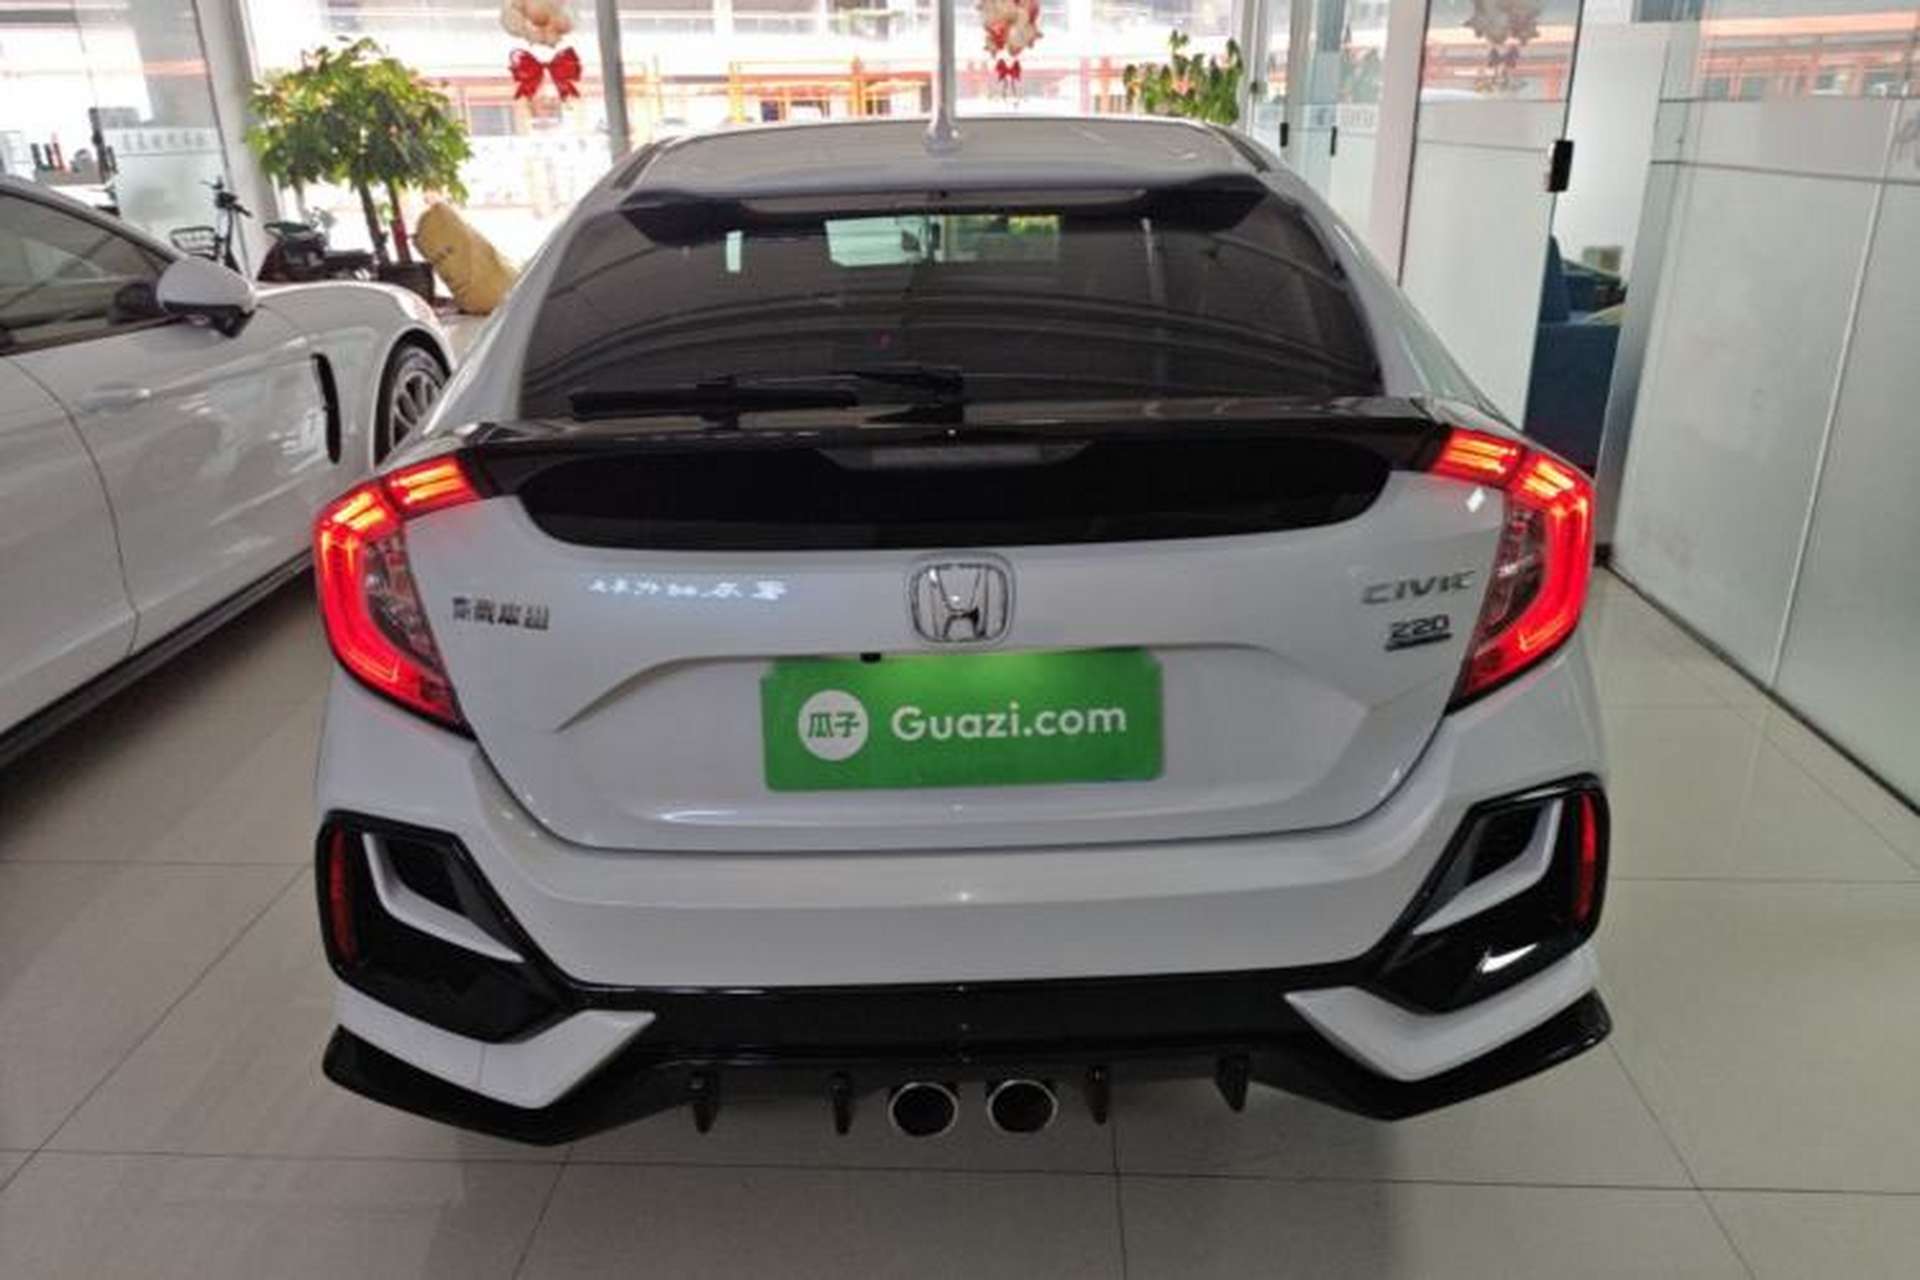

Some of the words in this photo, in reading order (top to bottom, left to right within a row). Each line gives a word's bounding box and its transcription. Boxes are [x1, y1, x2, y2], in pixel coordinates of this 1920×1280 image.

[1362, 570, 1475, 605] CIVIC
[1391, 613, 1450, 638] 220
[807, 711, 861, 739] 瓜子
[891, 702, 1127, 741] Guazi.com
